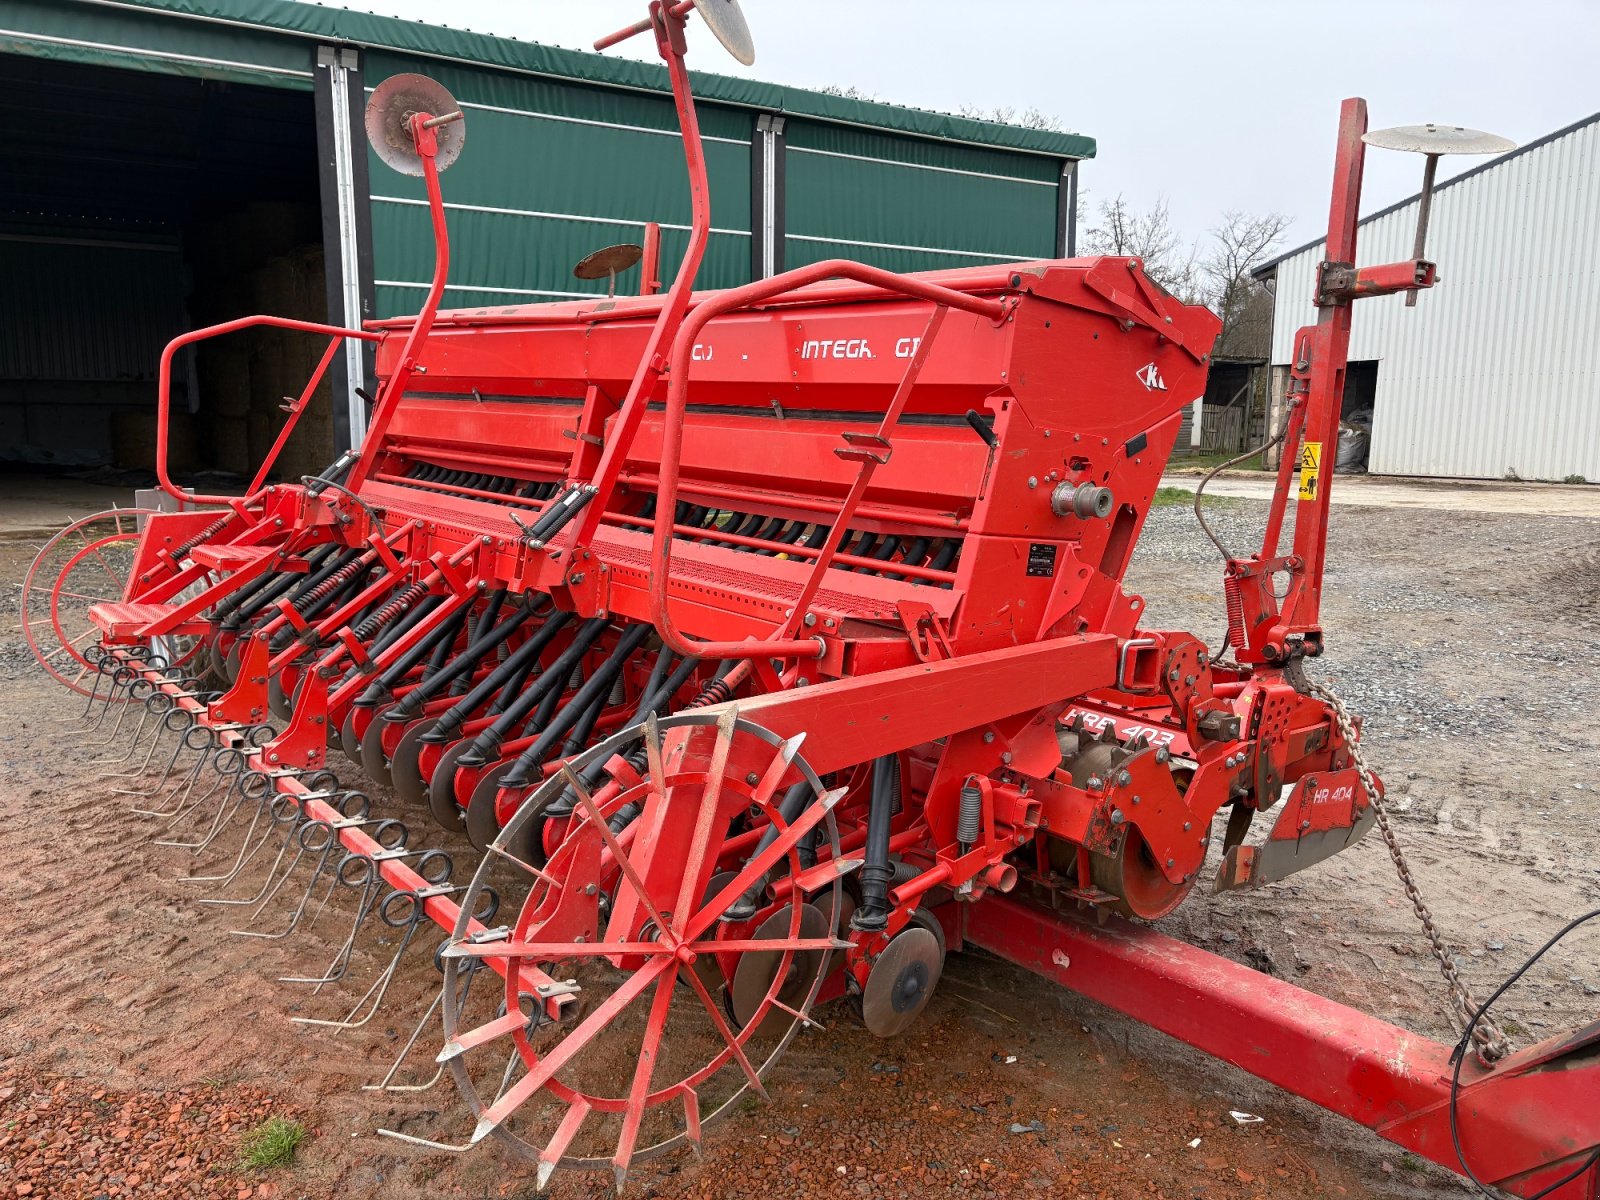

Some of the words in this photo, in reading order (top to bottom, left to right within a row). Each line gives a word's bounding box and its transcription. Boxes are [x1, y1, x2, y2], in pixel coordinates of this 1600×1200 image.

[1121, 725, 1175, 746] 403
[1313, 788, 1329, 804] HR
[1331, 786, 1353, 801] 404
